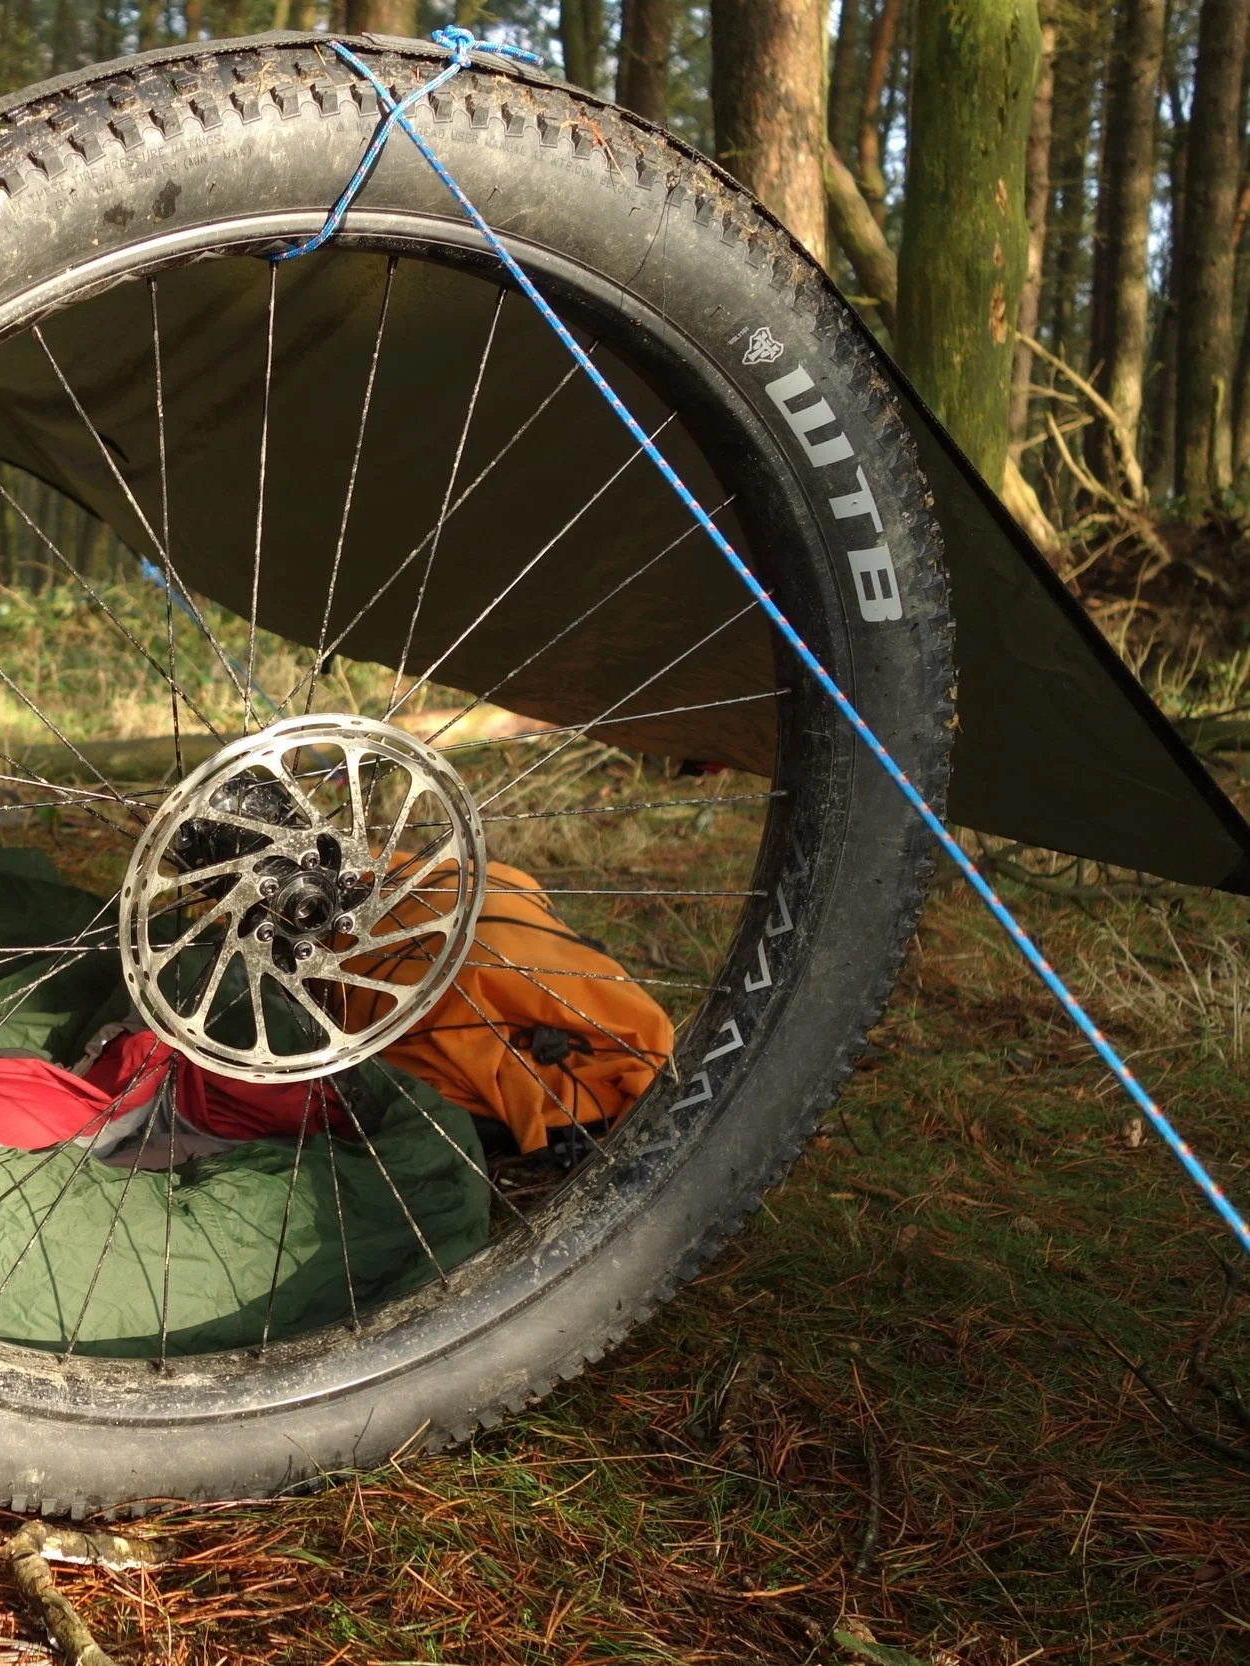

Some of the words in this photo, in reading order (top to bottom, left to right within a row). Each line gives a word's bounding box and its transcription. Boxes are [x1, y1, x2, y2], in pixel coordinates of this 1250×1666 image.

[449, 128, 481, 144] USER
[69, 166, 98, 188] TIRE
[102, 144, 166, 175] PRESSURE
[764, 364, 903, 623] WTB
